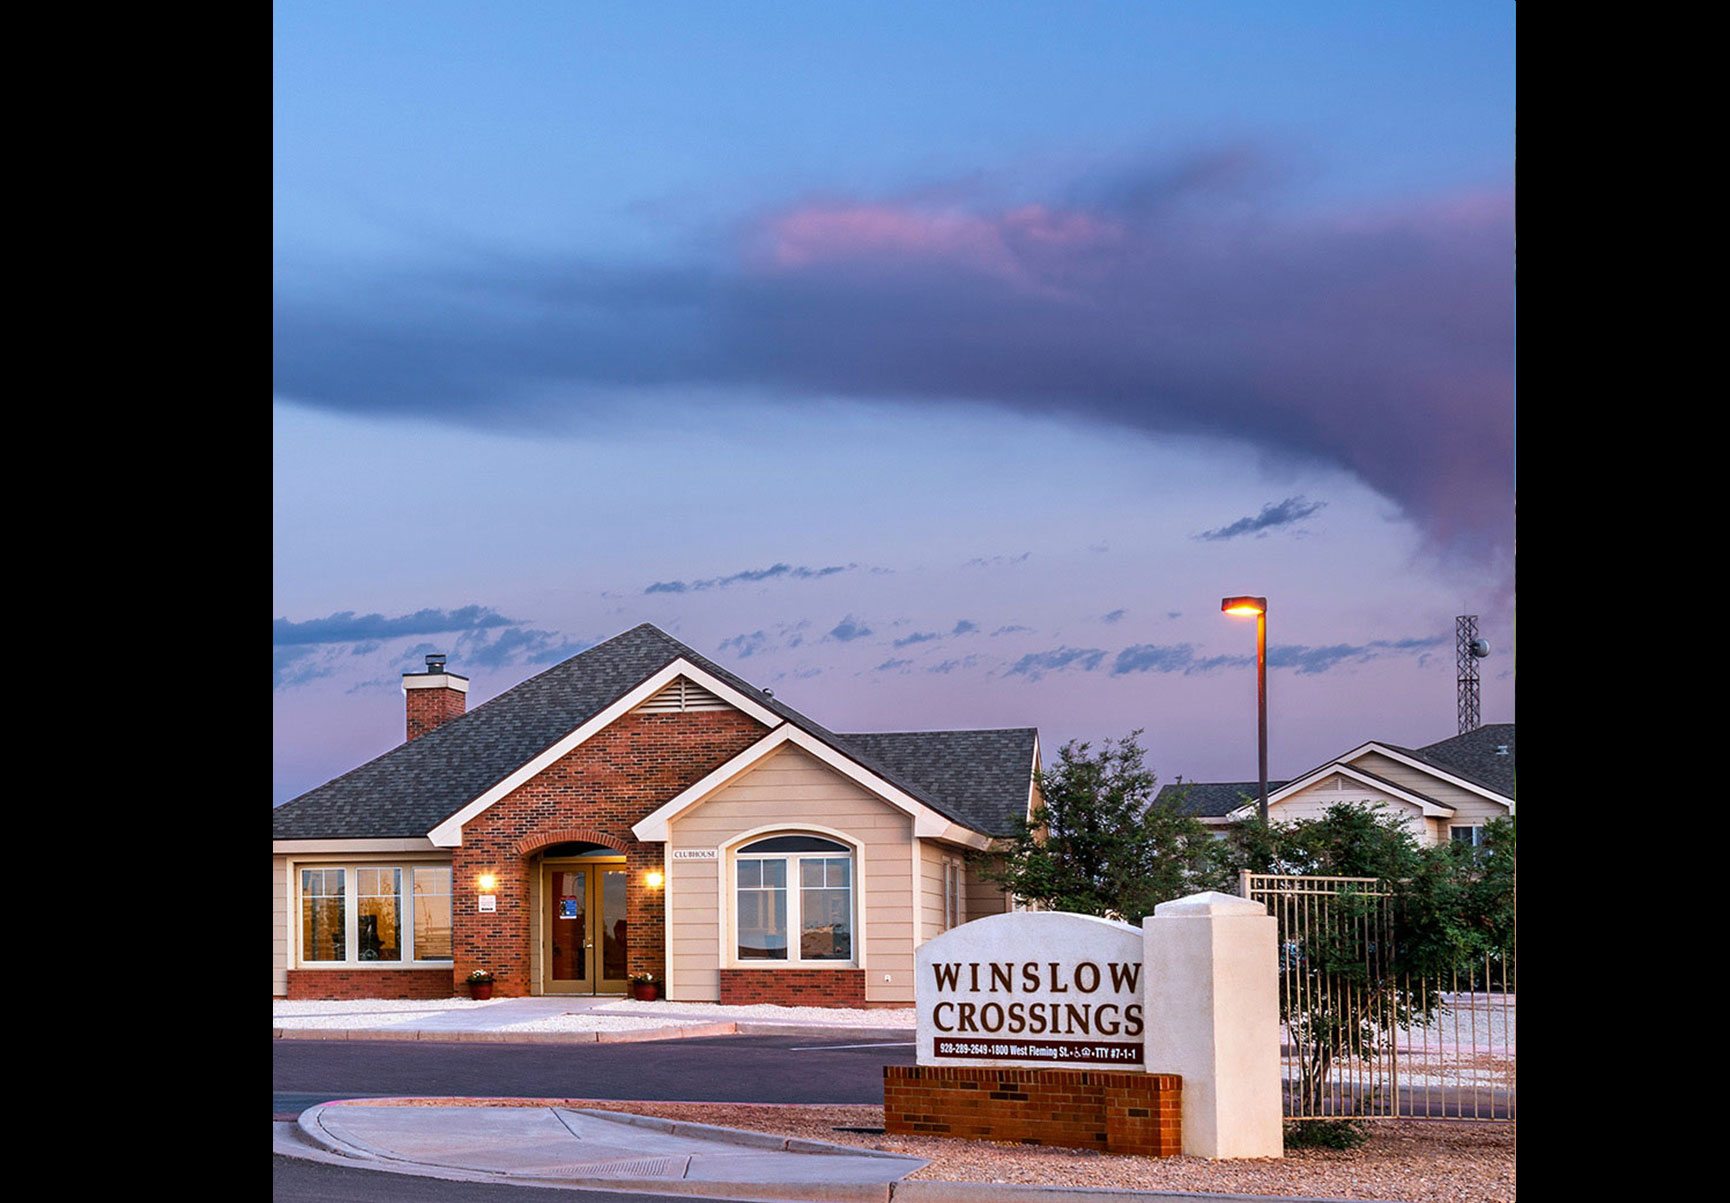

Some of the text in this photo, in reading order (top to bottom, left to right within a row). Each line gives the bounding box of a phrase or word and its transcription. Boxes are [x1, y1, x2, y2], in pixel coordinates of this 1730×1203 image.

[932, 961, 1142, 994] WINSLOW
[933, 1002, 1144, 1036] CROSSINGS
[940, 1043, 988, 1055] 928-289-2649
[991, 1044, 1009, 1056] 1800
[1010, 1045, 1028, 1056] West
[1029, 1045, 1058, 1059] Fleming
[1095, 1047, 1109, 1059] TTY
[1110, 1048, 1136, 1059] #7-1-1
